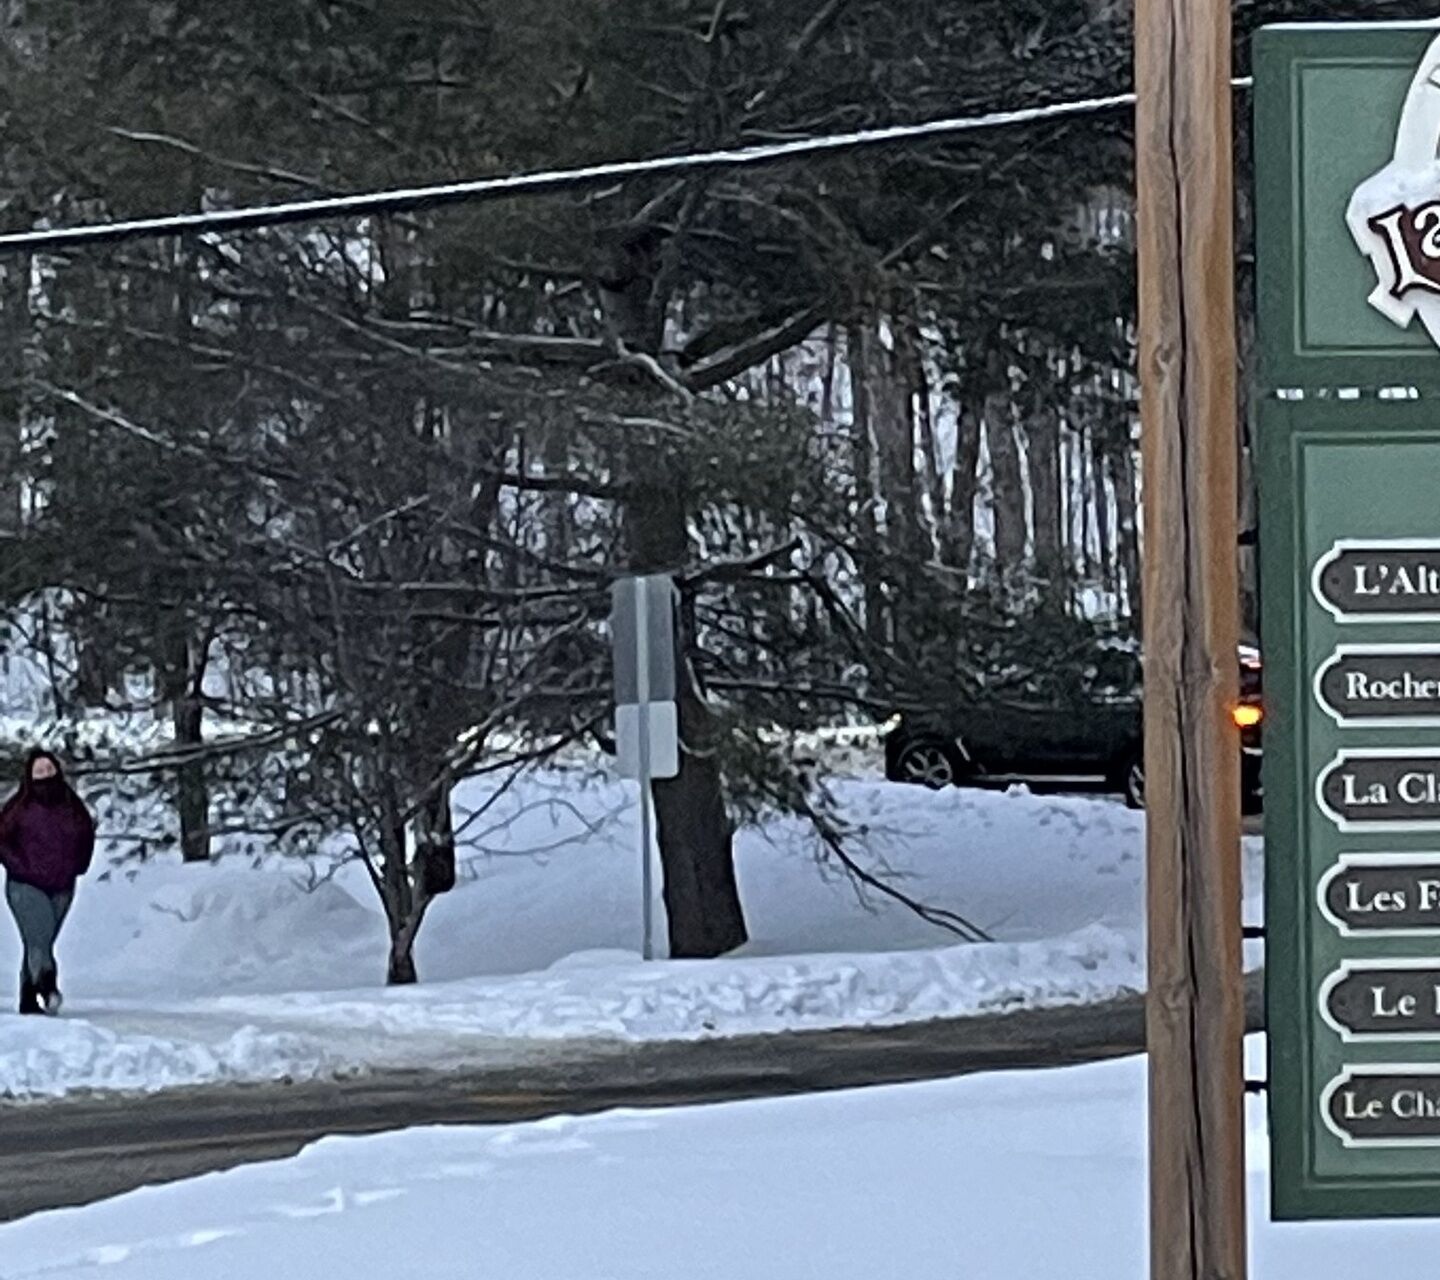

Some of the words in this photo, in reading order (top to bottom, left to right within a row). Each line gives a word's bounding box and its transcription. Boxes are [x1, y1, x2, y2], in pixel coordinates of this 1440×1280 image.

[1342, 774, 1389, 805] La
[1346, 882, 1407, 912] Les
[1371, 986, 1417, 1017] Le
[1344, 1091, 1385, 1119] Le
